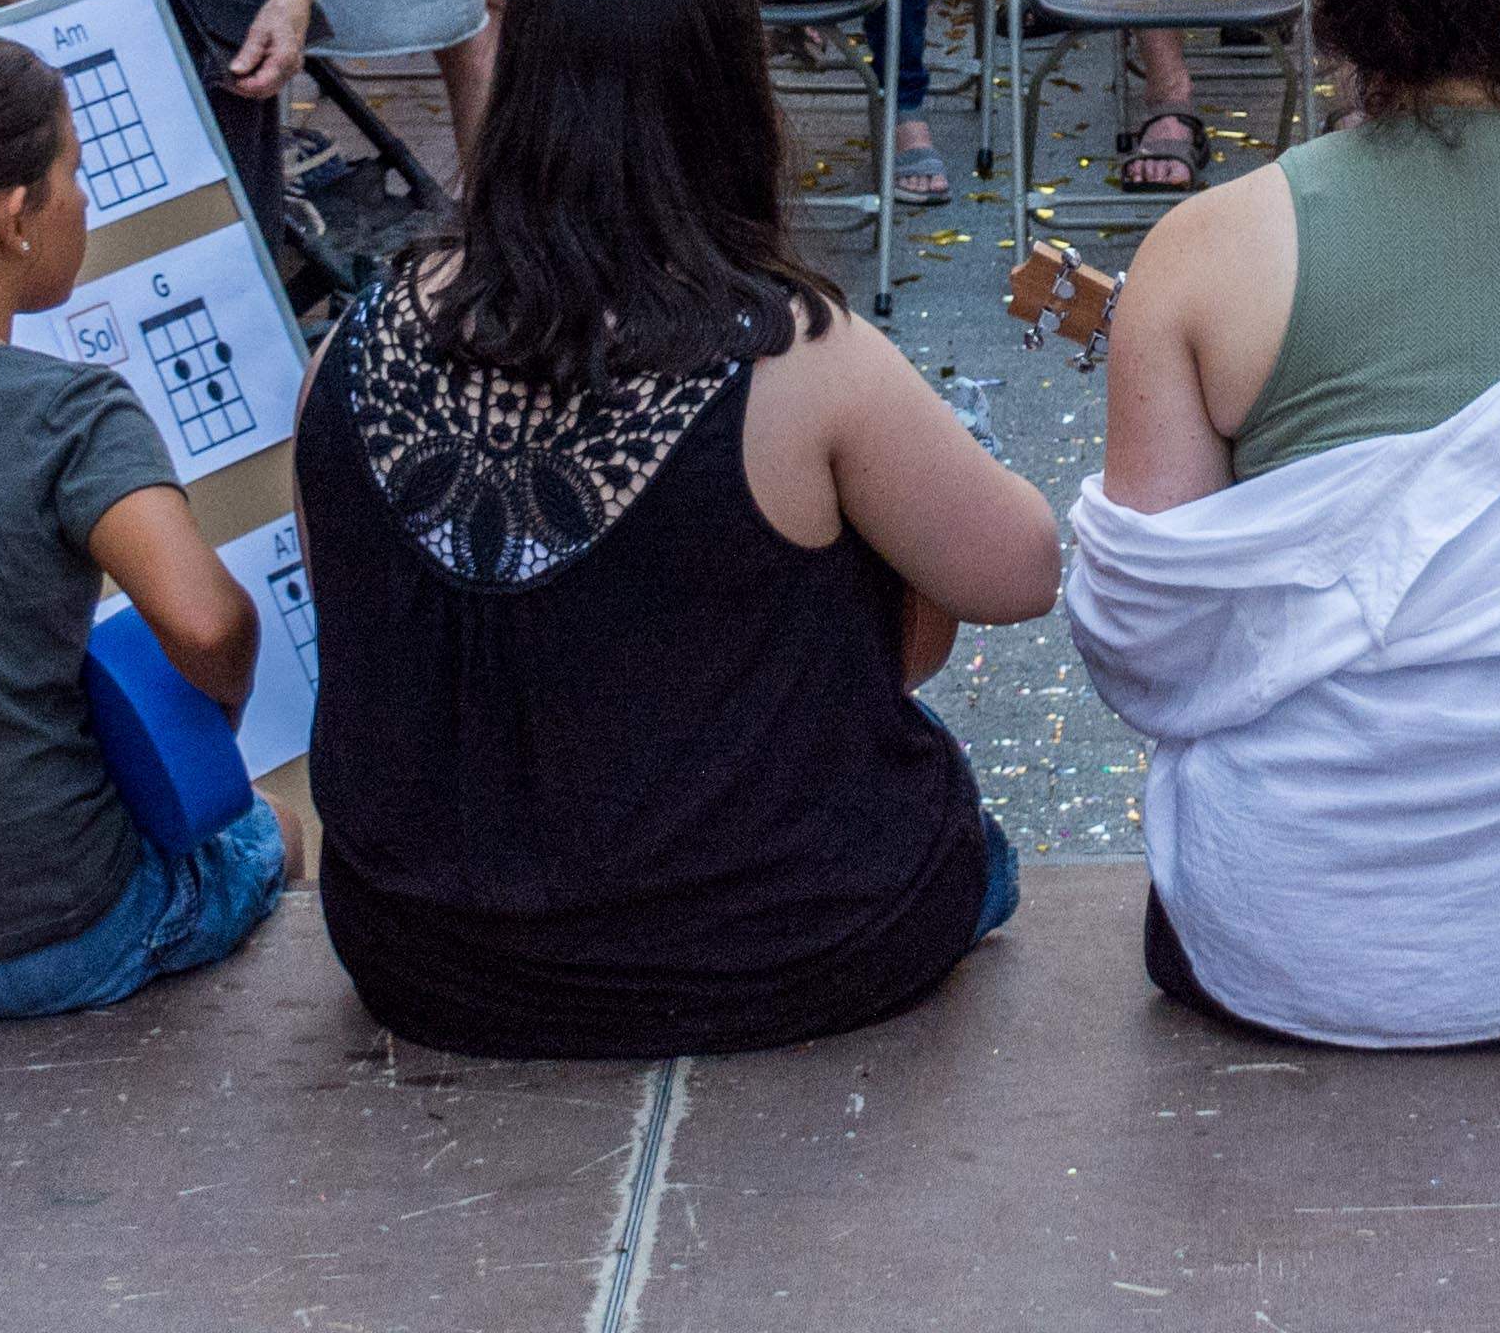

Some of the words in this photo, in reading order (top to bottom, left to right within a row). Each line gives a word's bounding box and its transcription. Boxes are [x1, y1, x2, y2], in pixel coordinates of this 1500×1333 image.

[52, 20, 90, 52] Am
[152, 272, 171, 299] G
[78, 317, 119, 359] Sol
[274, 526, 297, 560] A7
